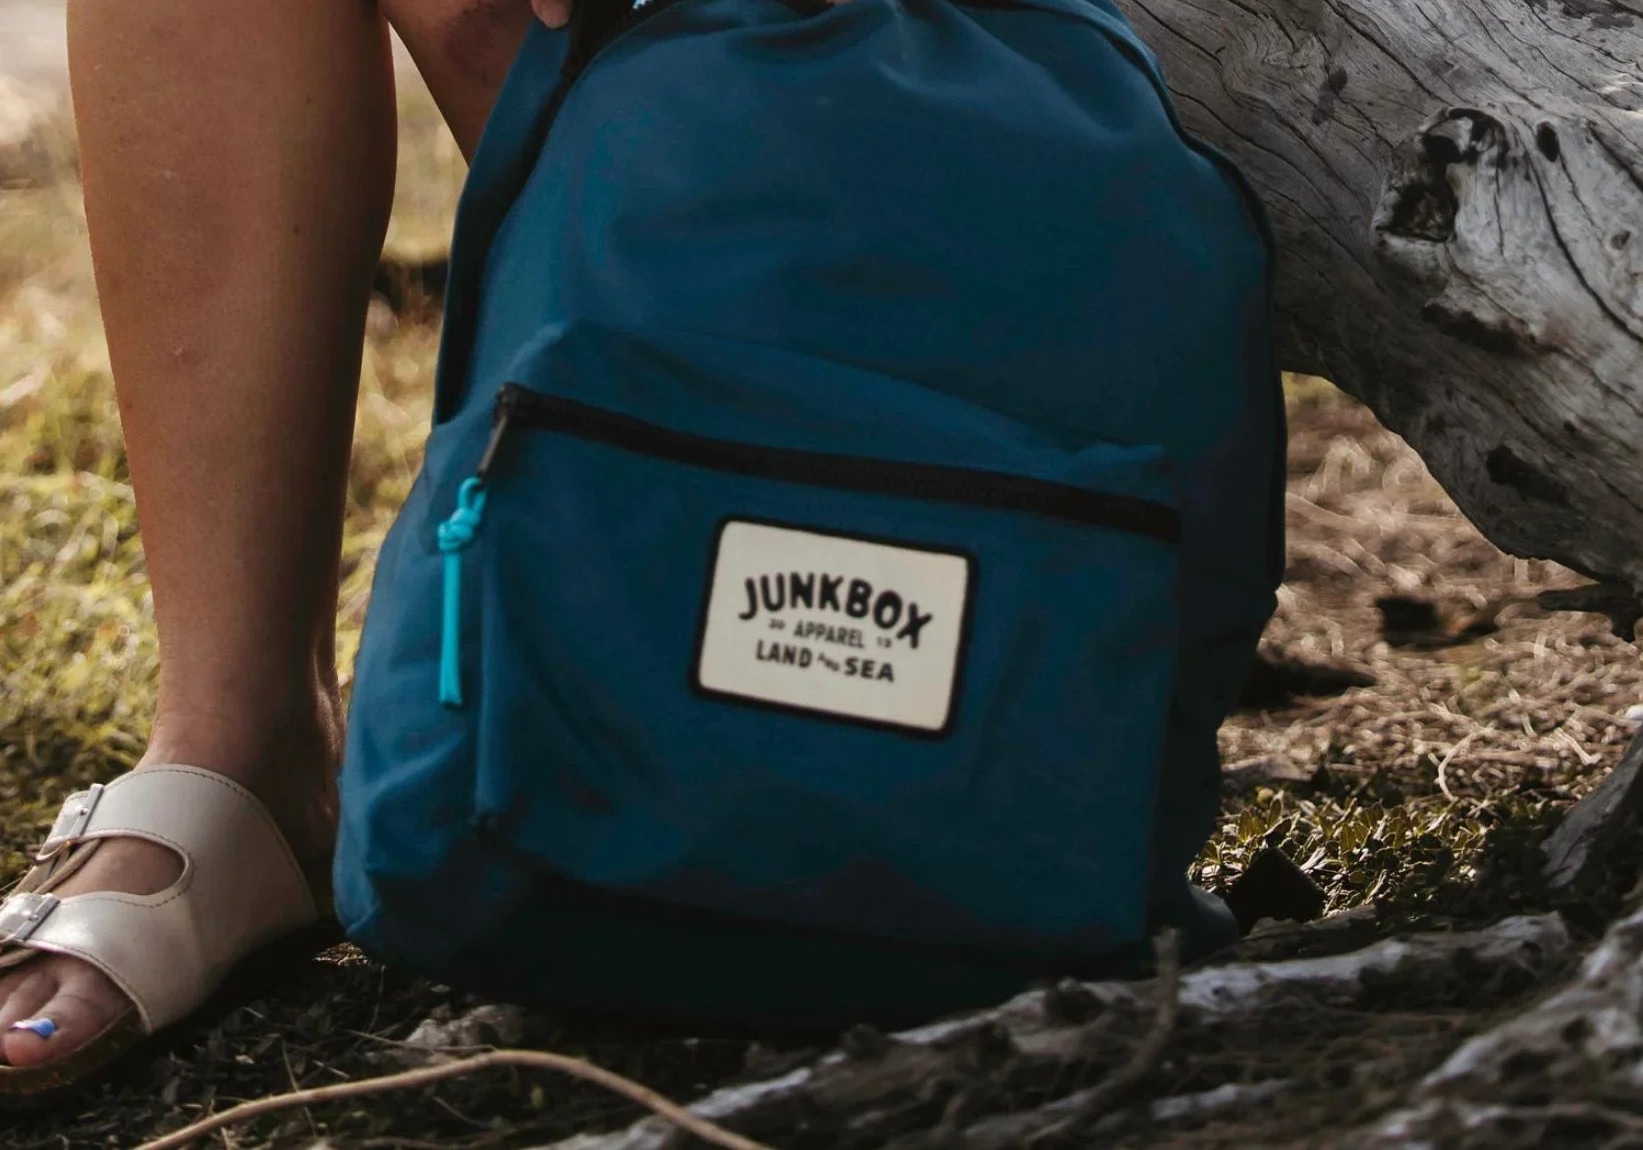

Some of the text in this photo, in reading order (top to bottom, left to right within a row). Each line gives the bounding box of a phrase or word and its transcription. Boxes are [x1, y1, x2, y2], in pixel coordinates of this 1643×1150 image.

[738, 571, 933, 650] JUNKBOX
[793, 619, 865, 649] APPAREL
[756, 639, 813, 668] LAND
[844, 656, 895, 683] SEA
